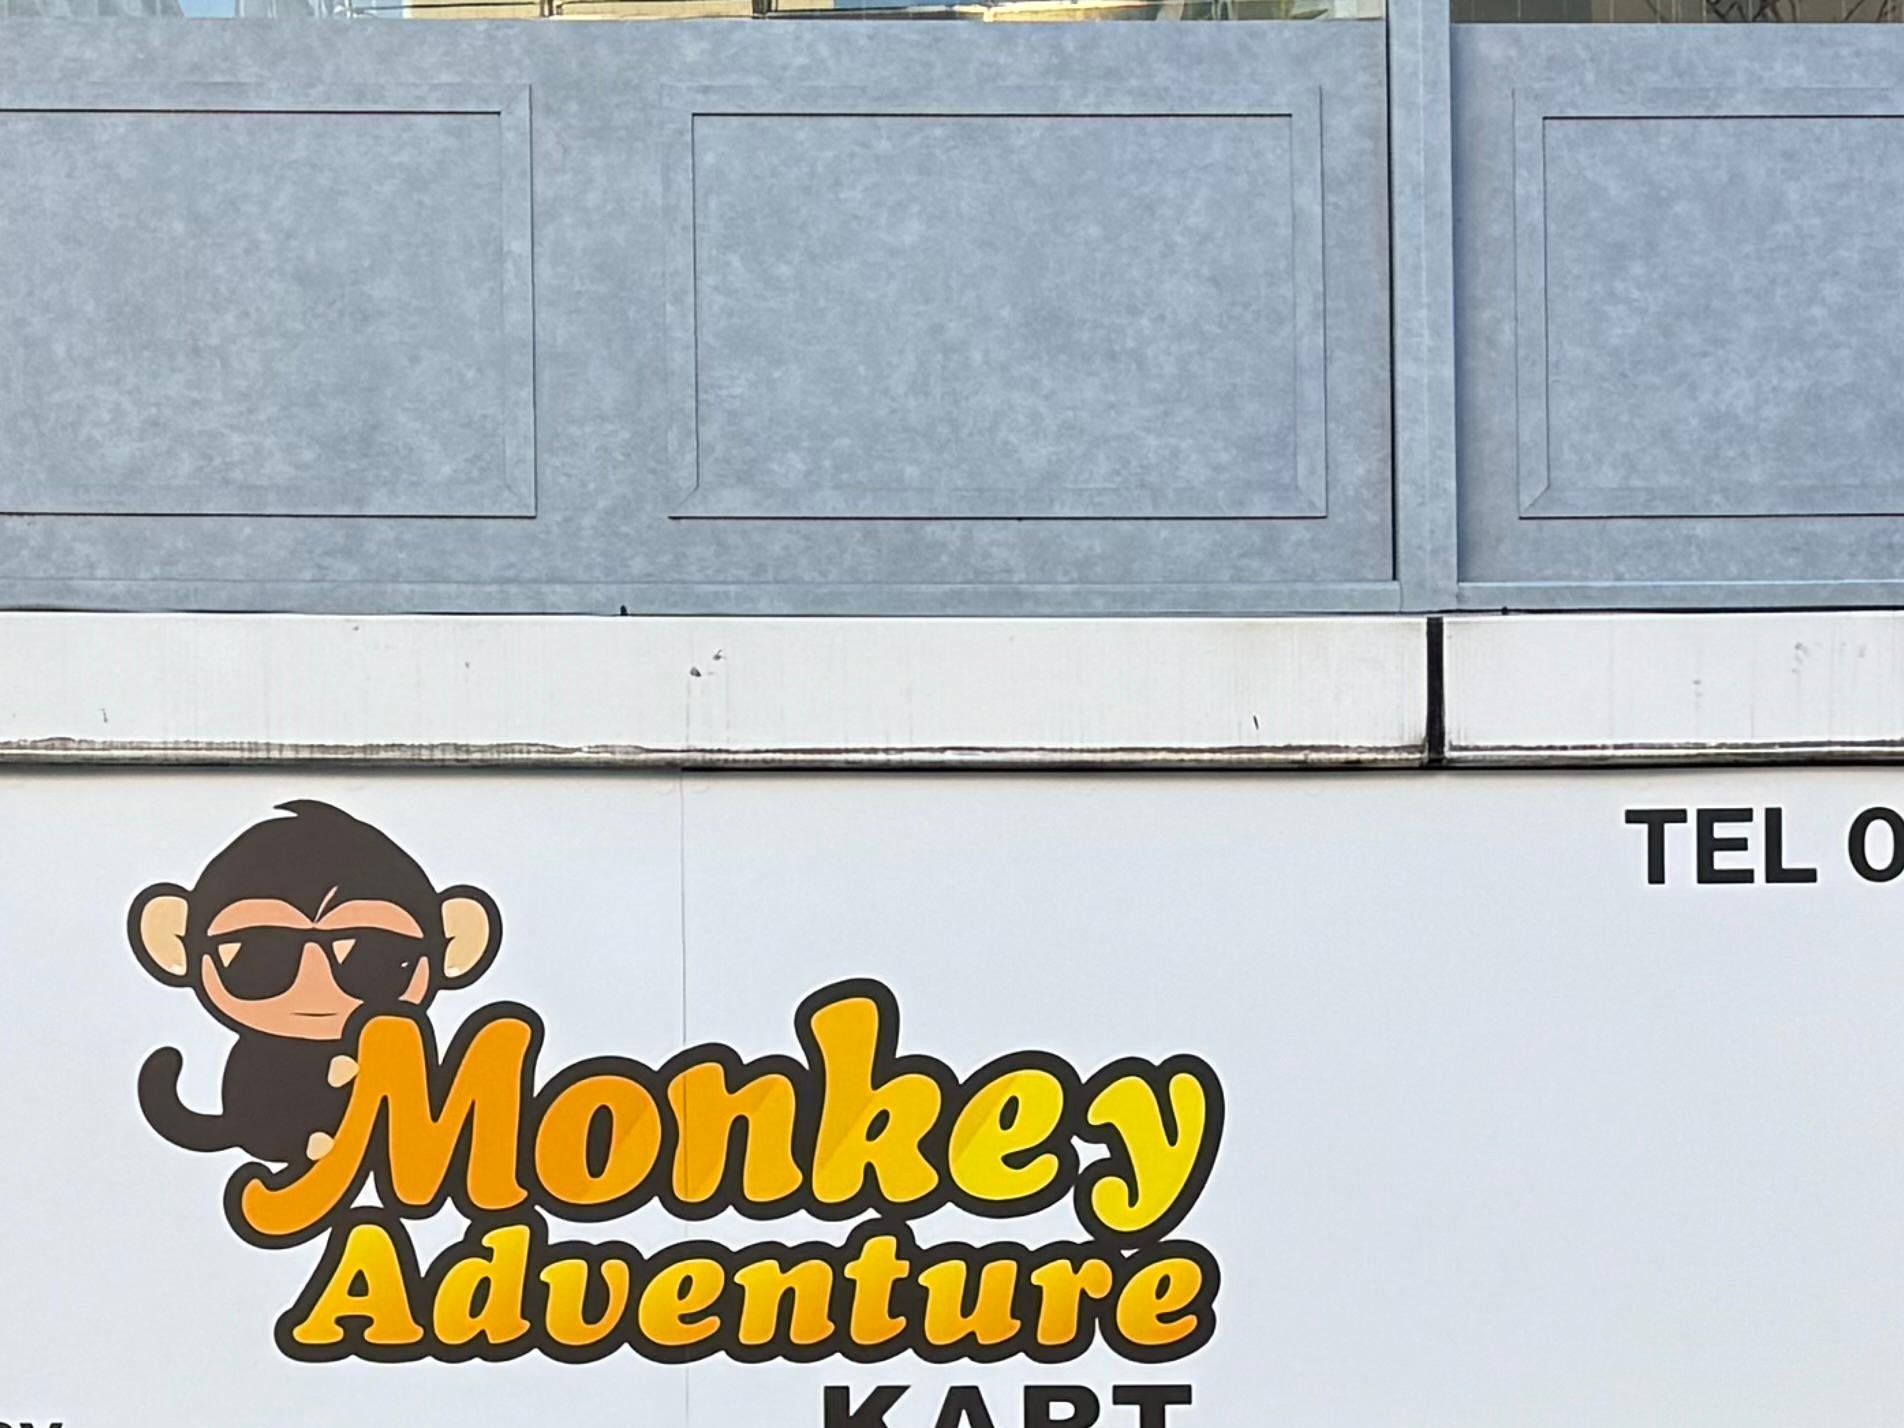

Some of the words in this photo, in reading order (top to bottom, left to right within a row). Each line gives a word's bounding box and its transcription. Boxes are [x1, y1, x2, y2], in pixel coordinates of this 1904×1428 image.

[1625, 807, 1817, 885] TEL
[231, 986, 1218, 1245] Monkey
[282, 1215, 1211, 1354] Adventure
